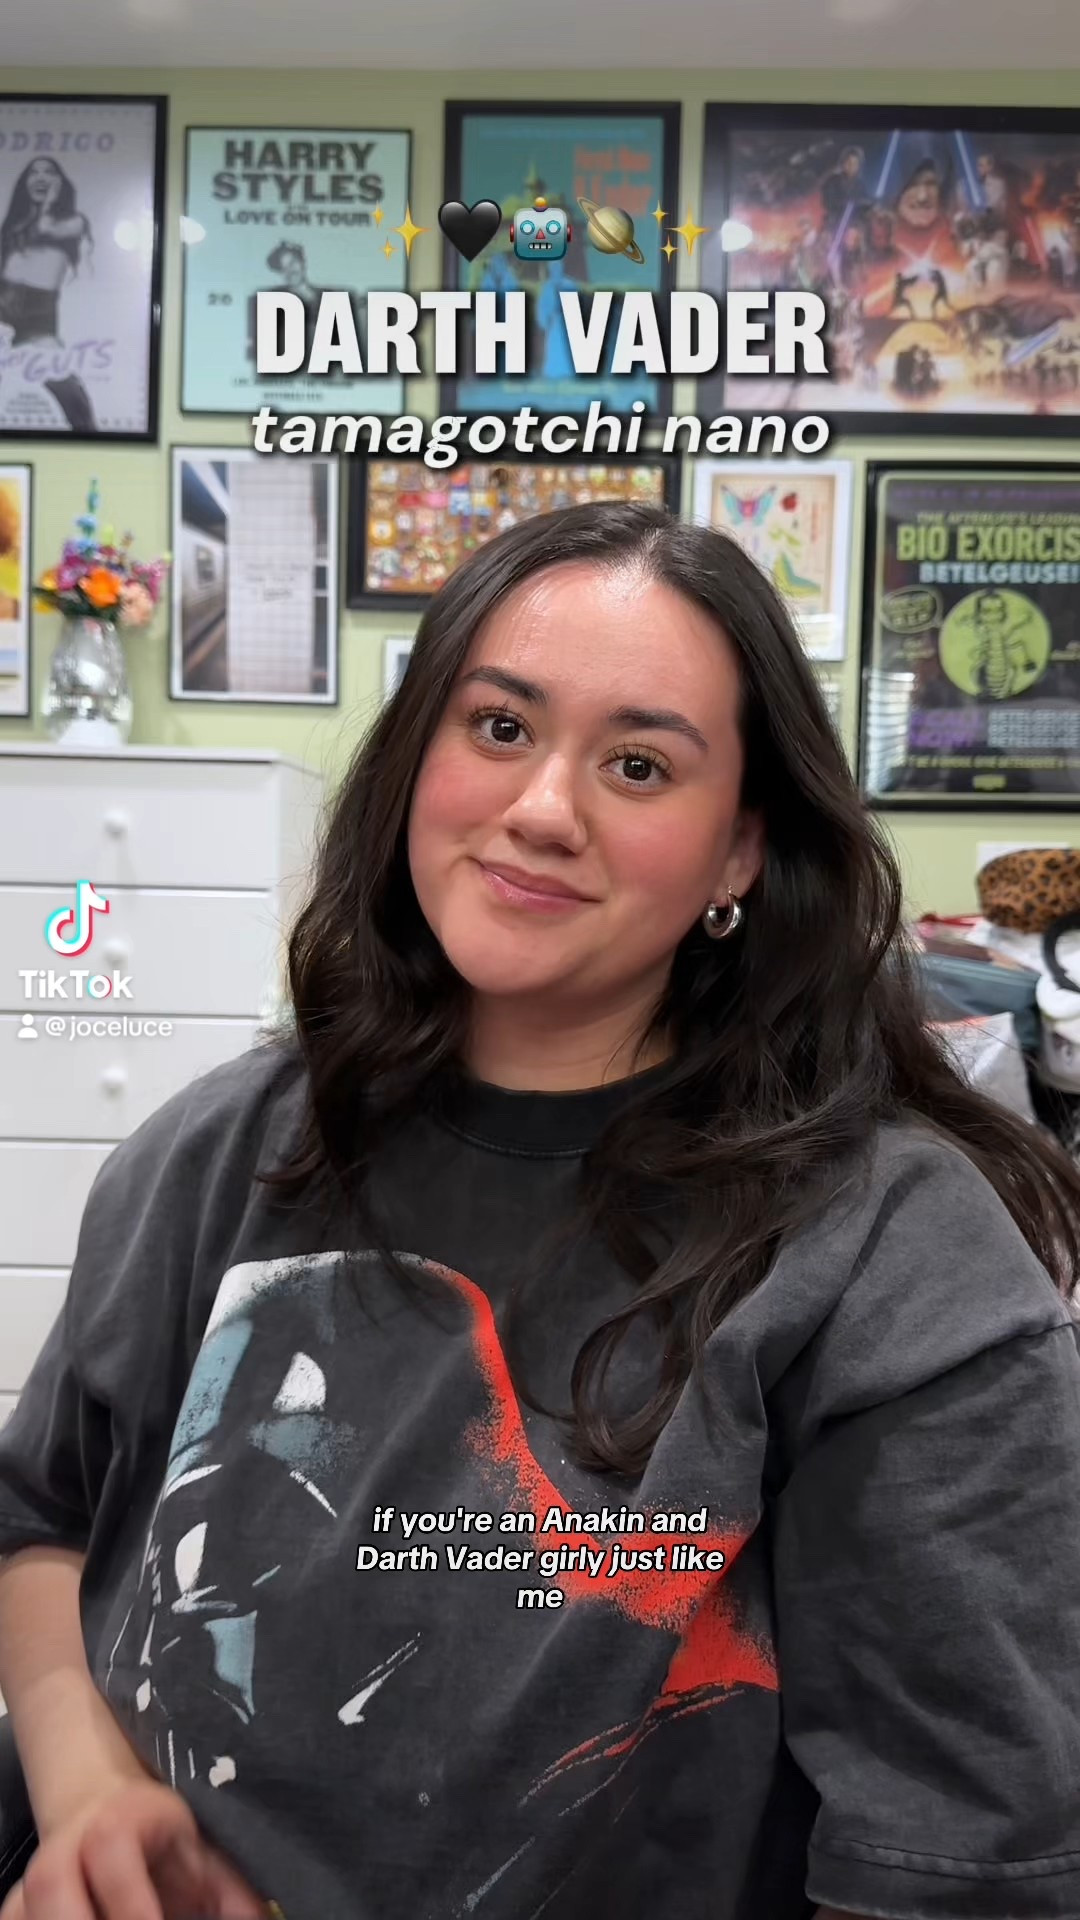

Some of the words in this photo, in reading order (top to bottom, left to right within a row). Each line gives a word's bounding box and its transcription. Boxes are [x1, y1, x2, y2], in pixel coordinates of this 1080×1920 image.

[224, 140, 376, 171] HARRY
[212, 172, 384, 204] STYLES
[224, 209, 277, 225] LOVE
[316, 211, 372, 227] TOUR
[896, 525, 948, 561] BIO
[919, 563, 1080, 585] BETELGEUSE!
